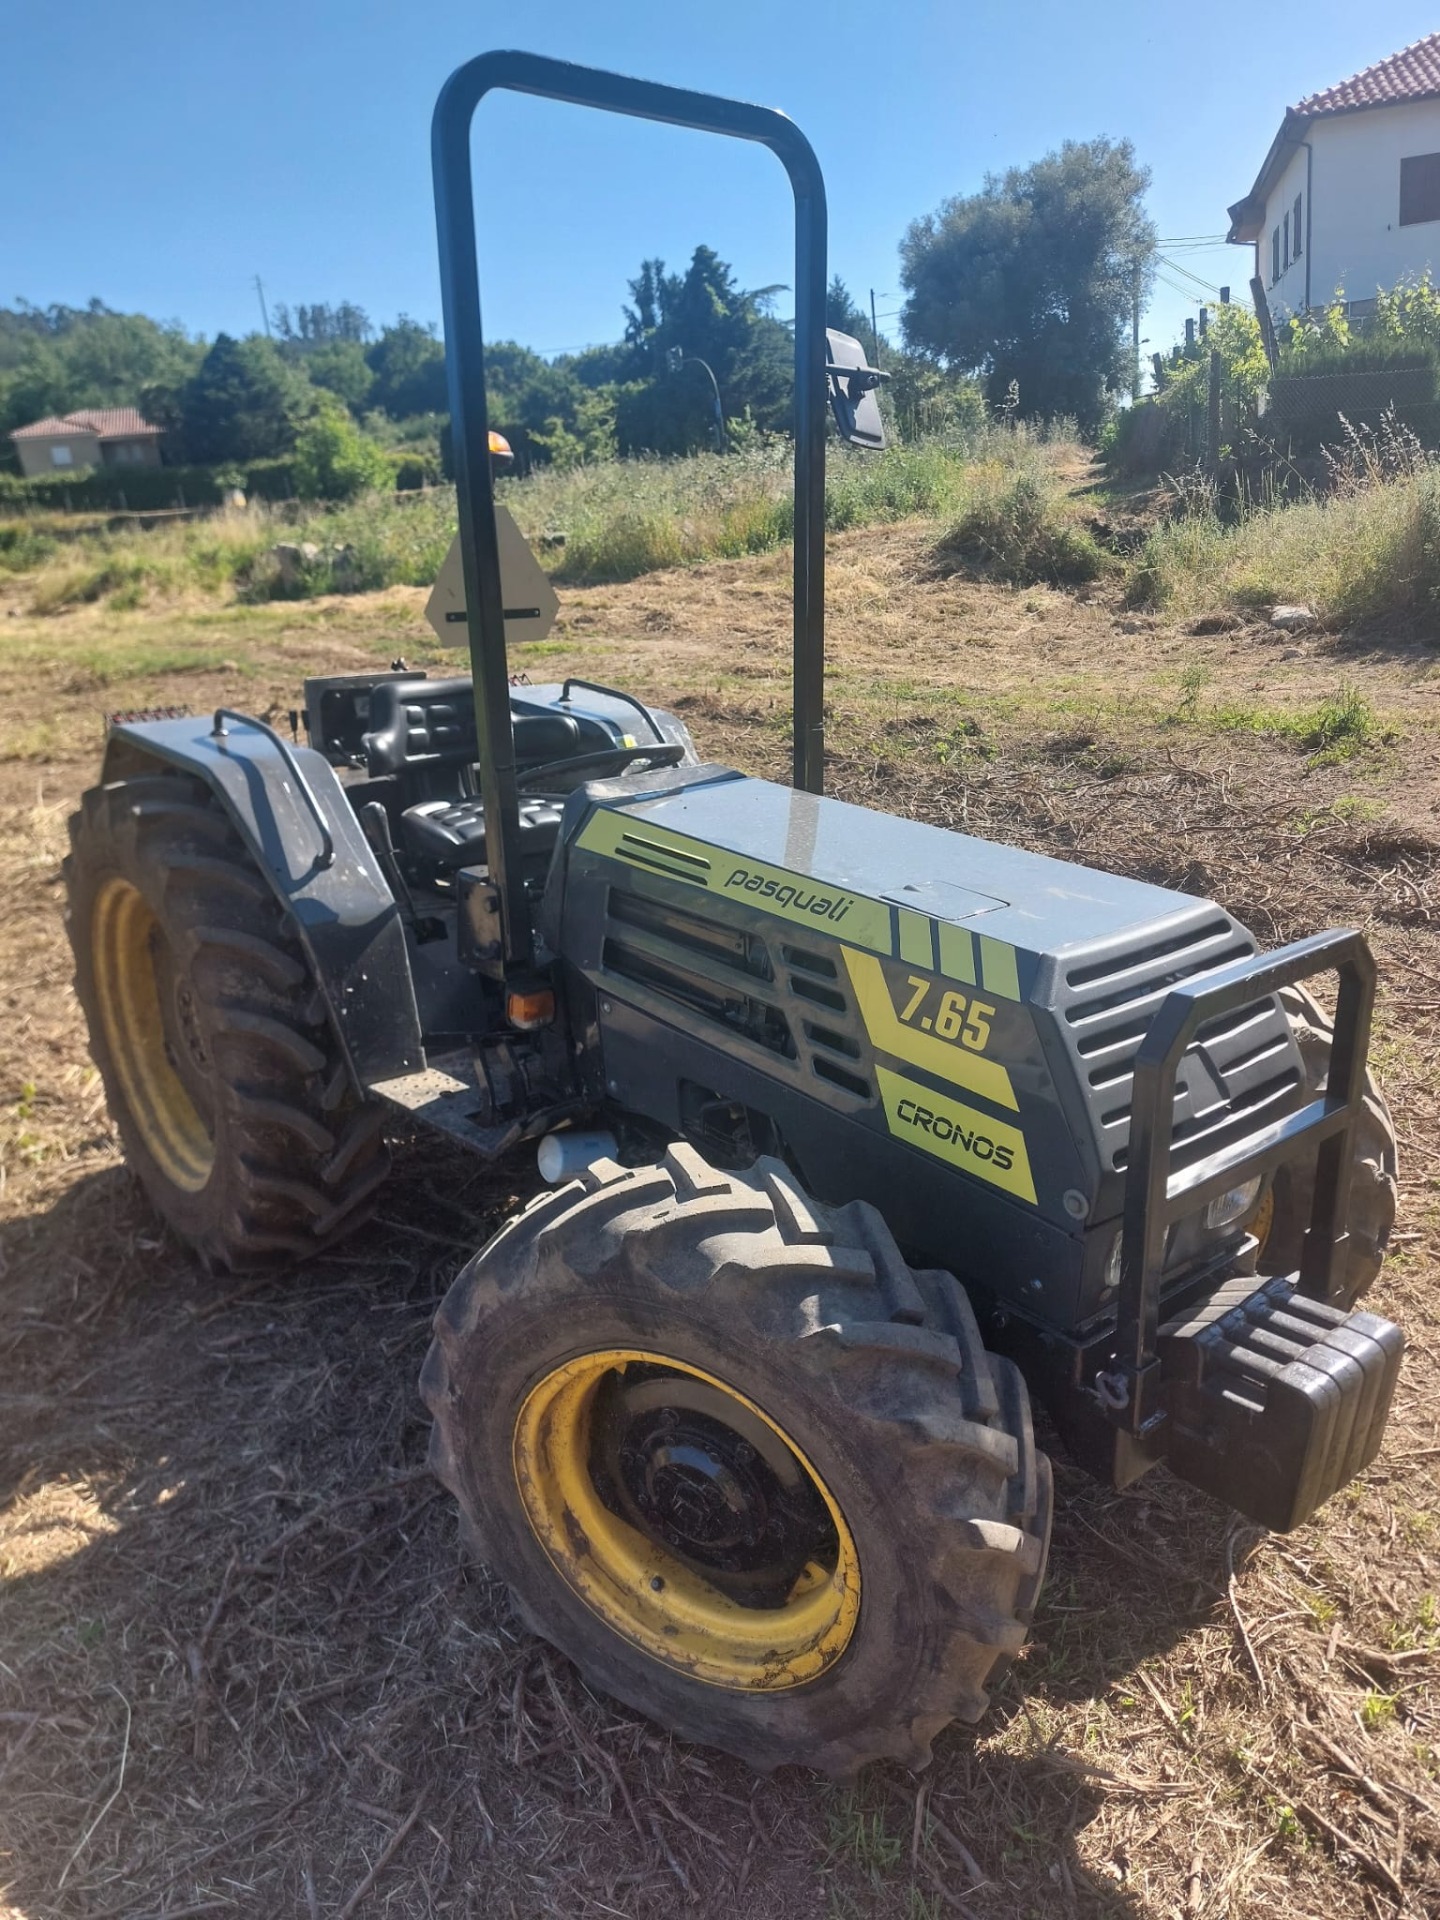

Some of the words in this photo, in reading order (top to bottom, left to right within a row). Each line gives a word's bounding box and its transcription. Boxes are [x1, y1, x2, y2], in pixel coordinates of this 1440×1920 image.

[724, 869, 854, 922] pasquali
[900, 975, 995, 1051] 7.65
[897, 1099, 1014, 1170] CRONOS
